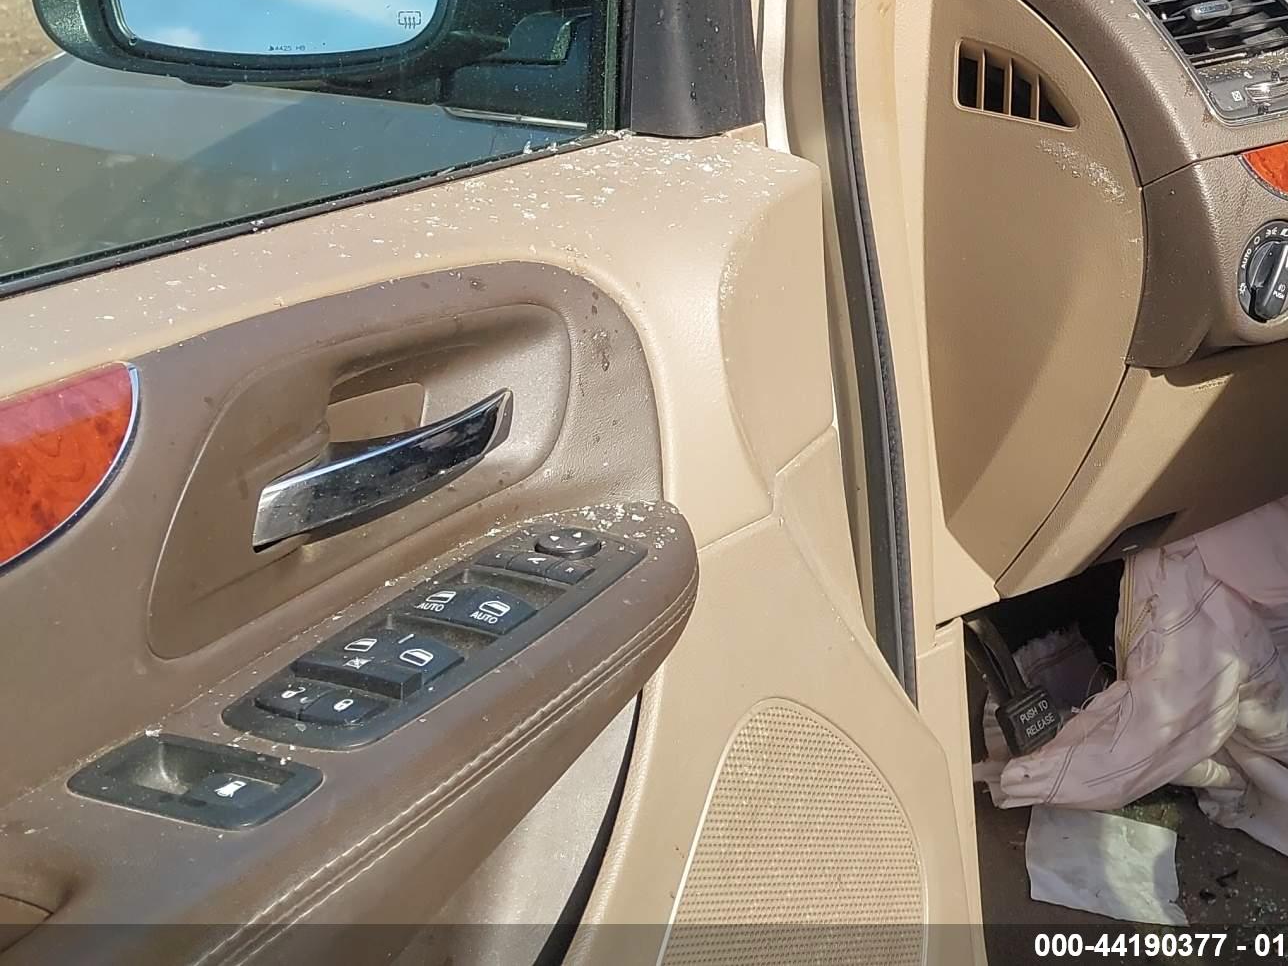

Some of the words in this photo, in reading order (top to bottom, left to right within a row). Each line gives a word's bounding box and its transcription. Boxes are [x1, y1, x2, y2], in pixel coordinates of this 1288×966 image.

[1241, 249, 1252, 269] AUTO
[416, 602, 445, 612] AUTO
[470, 611, 498, 623] AUTO
[1020, 706, 1038, 723] PUSH
[1039, 700, 1048, 711] TO
[1026, 713, 1055, 737] RELEASE
